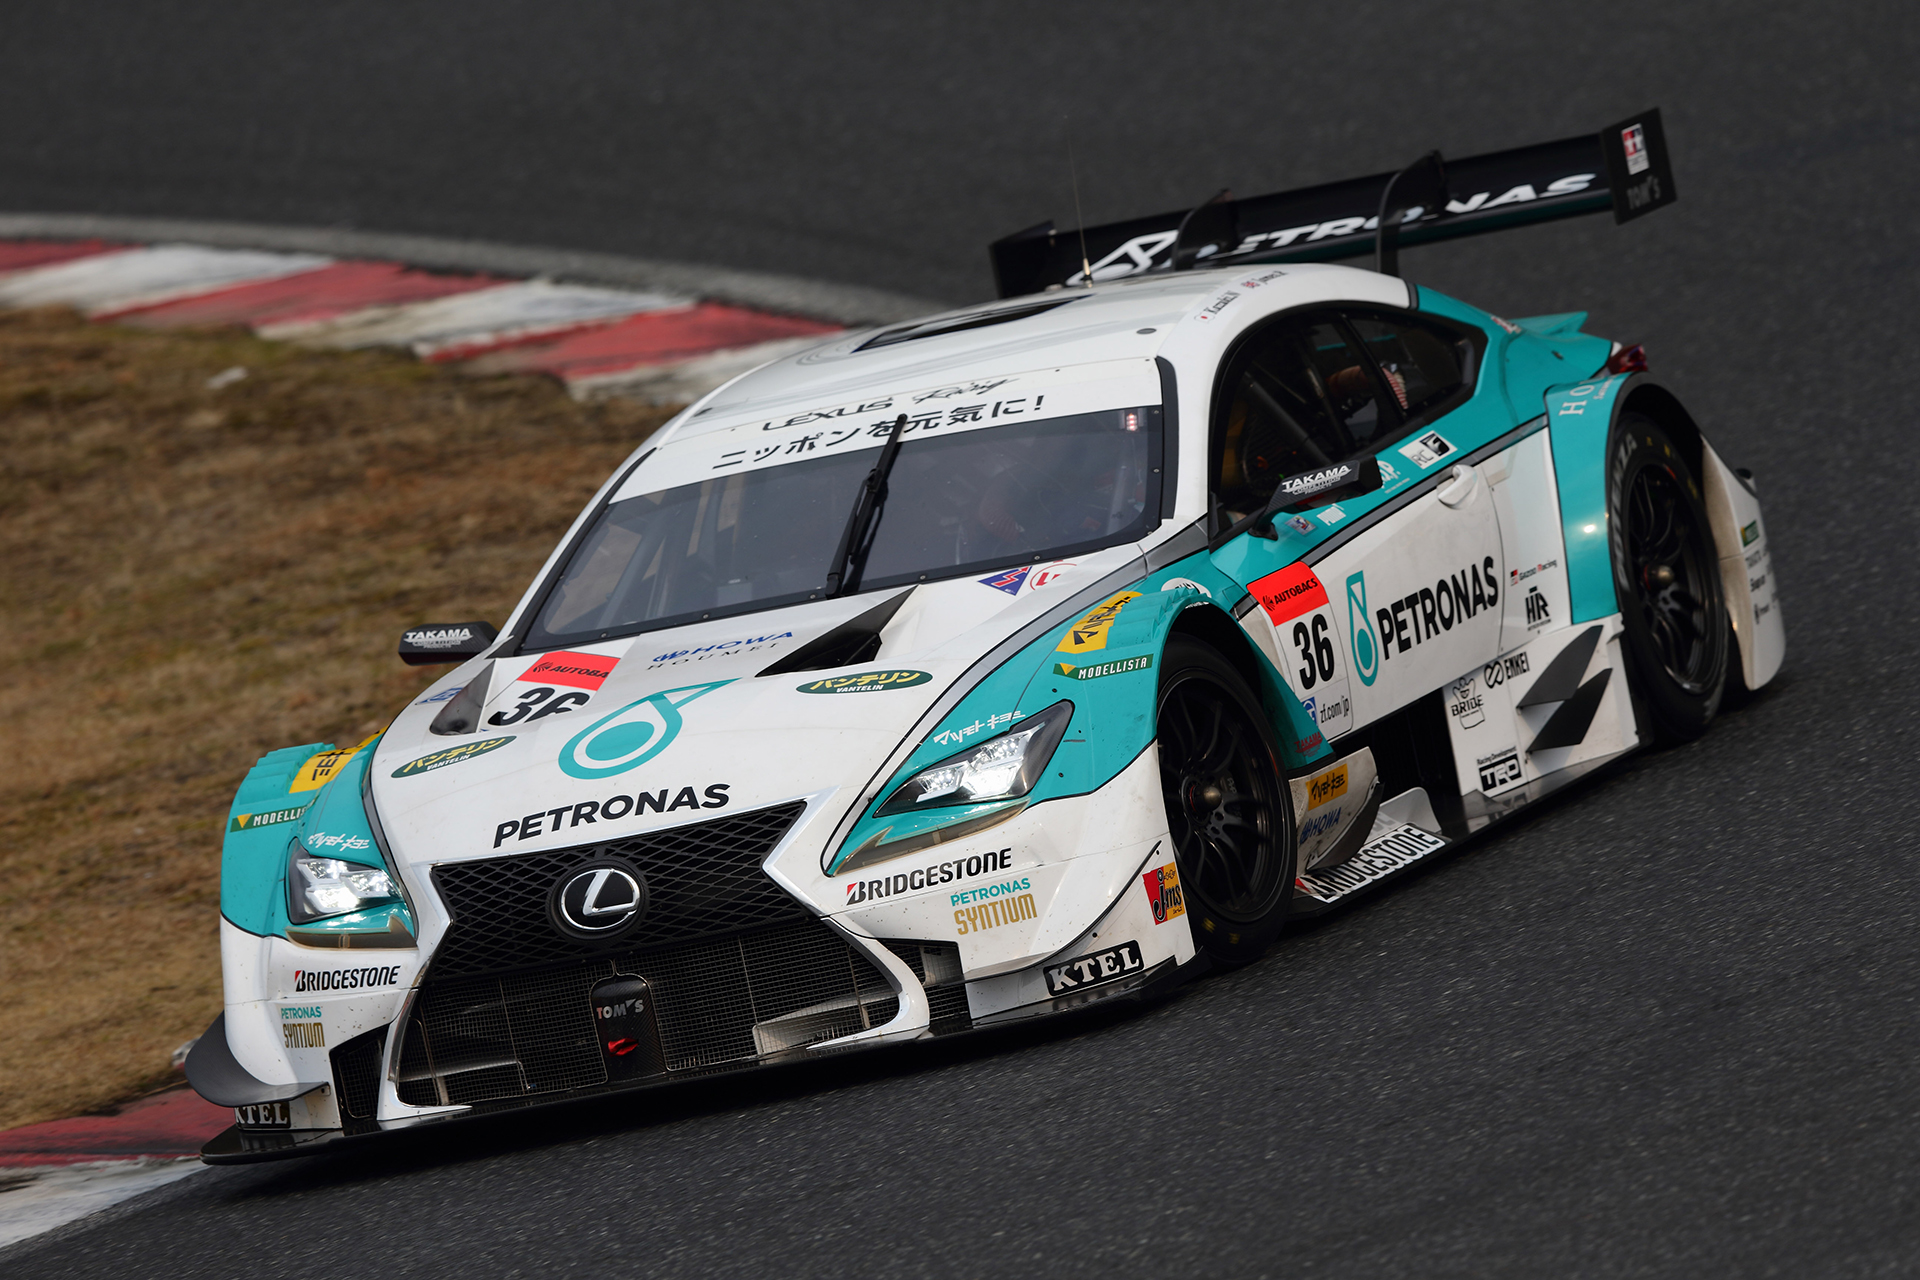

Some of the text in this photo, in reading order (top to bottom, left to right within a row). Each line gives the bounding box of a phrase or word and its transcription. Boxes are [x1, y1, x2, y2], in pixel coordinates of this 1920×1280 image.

[762, 398, 893, 432] LEXUS
[1282, 465, 1352, 493] TAKAMA
[1274, 577, 1319, 606] AUTOBACS
[1376, 556, 1499, 661] PETRONAS
[404, 628, 473, 643] TAKAMA
[1293, 613, 1335, 690] 36
[1504, 652, 1530, 679] ENKEI
[550, 665, 610, 678] AUTOBA
[810, 672, 921, 690] バンテリン
[1078, 657, 1148, 679] MODELLISTA
[836, 684, 884, 693] VANTELIN
[1451, 694, 1484, 717] BRIDE
[933, 710, 1026, 746] マツモトキヨシ
[403, 738, 506, 773] バンテリン
[1294, 731, 1323, 754] TAKAMA
[426, 754, 471, 771] VANTELIN
[1480, 757, 1520, 789] TRD
[493, 783, 730, 849] PETRONAS
[846, 847, 1012, 906] BRIDGESTONE
[1298, 827, 1440, 901] BRIDGESTONE
[950, 877, 1031, 907] PETRONAS
[953, 893, 1038, 936] SYNTIUM
[294, 965, 401, 992] BRIDGESTONE
[1048, 946, 1140, 992] KTEL
[281, 1006, 322, 1019] PETRONAS
[596, 998, 645, 1020] TOM'S
[283, 1022, 326, 1048] SYNTIUM
